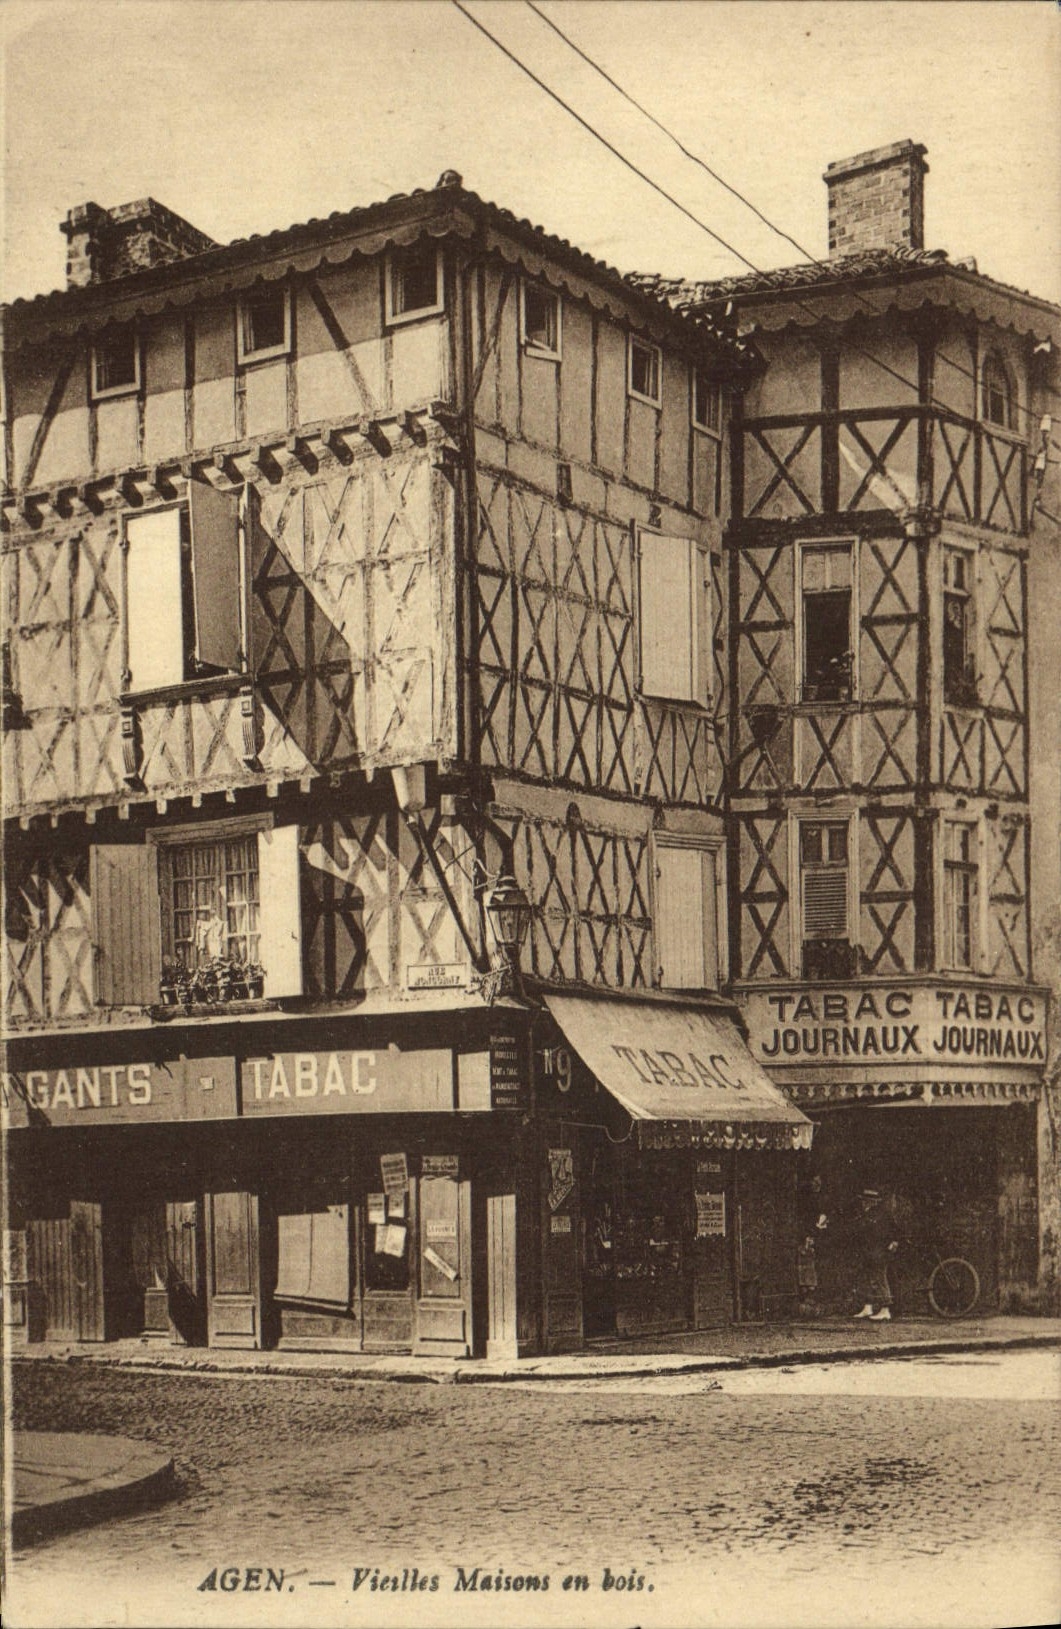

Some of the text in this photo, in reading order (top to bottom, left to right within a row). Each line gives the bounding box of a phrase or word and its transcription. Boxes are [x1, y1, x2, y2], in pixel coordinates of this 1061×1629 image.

[768, 991, 914, 1022] TABAC
[935, 991, 1035, 1024] TABAC
[762, 1024, 922, 1057] JOURNAUX
[933, 1025, 1045, 1060] JOURNAUX
[246, 1053, 376, 1100] TABAC
[611, 1044, 748, 1090] TABAC
[26, 1063, 152, 1110] GANTS
